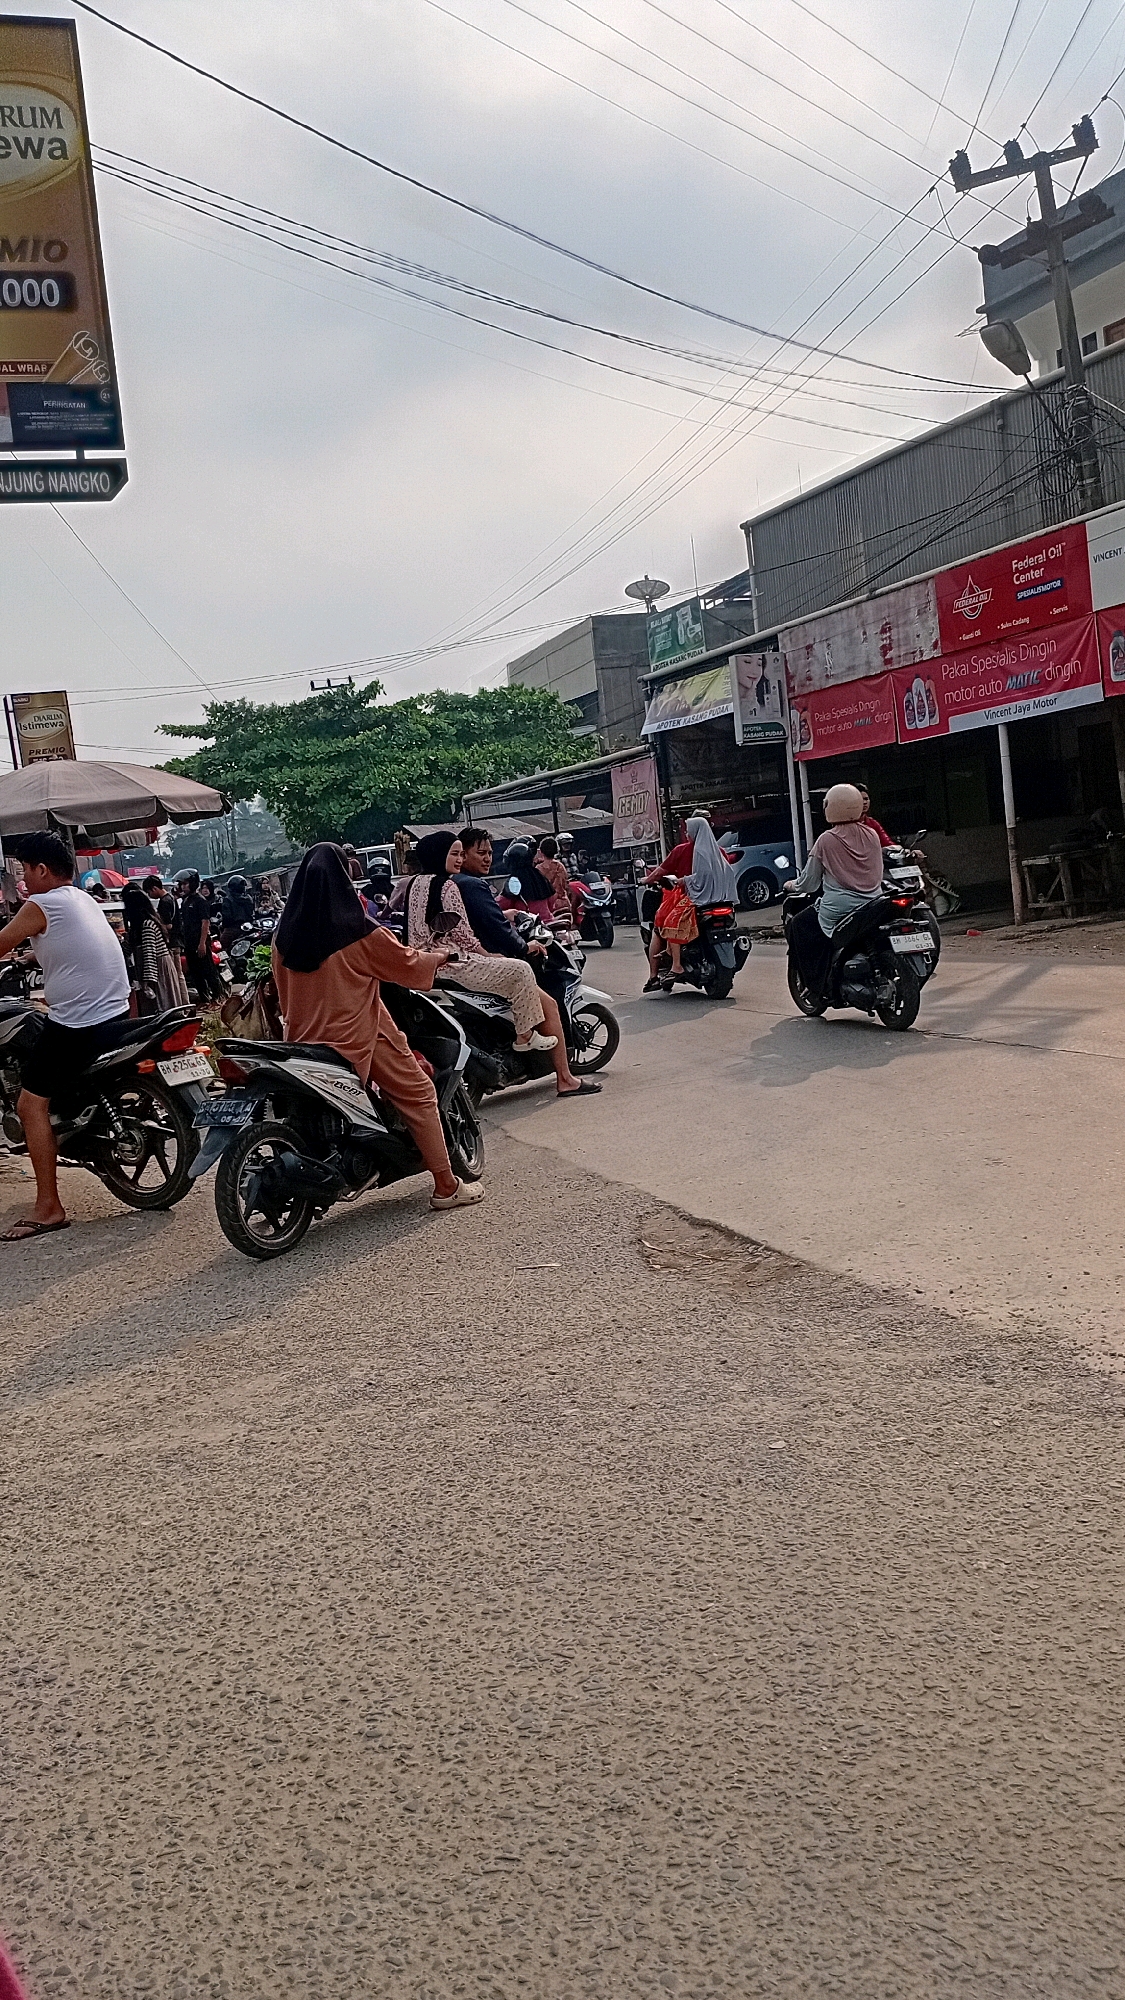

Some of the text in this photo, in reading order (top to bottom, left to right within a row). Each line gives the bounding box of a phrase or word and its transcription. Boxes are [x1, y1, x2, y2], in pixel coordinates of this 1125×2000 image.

[0, 364, 15, 373] AL
[43, 400, 86, 409] PERINGATAN
[48, 471, 110, 493] NANGKO
[1012, 549, 1046, 573] Federal
[1093, 547, 1122, 563] VINCENT
[1013, 567, 1045, 585] Center
[1053, 604, 1068, 614] Servis
[941, 637, 1057, 680] Pakai Spesialis Dingin
[944, 686, 976, 704] motor
[978, 679, 1003, 697] auto
[1044, 657, 1082, 682] dingin
[984, 697, 1058, 721] Vincent Jaya Motor
[19, 720, 64, 731] Istimewa
[655, 704, 729, 731] APOTEK KASANG PUDAK
[765, 730, 784, 738] PUDAK
[816, 724, 836, 736] motor
[837, 720, 852, 732] auto
[29, 747, 66, 756] PREMIO
[194, 1055, 207, 1066] GS
